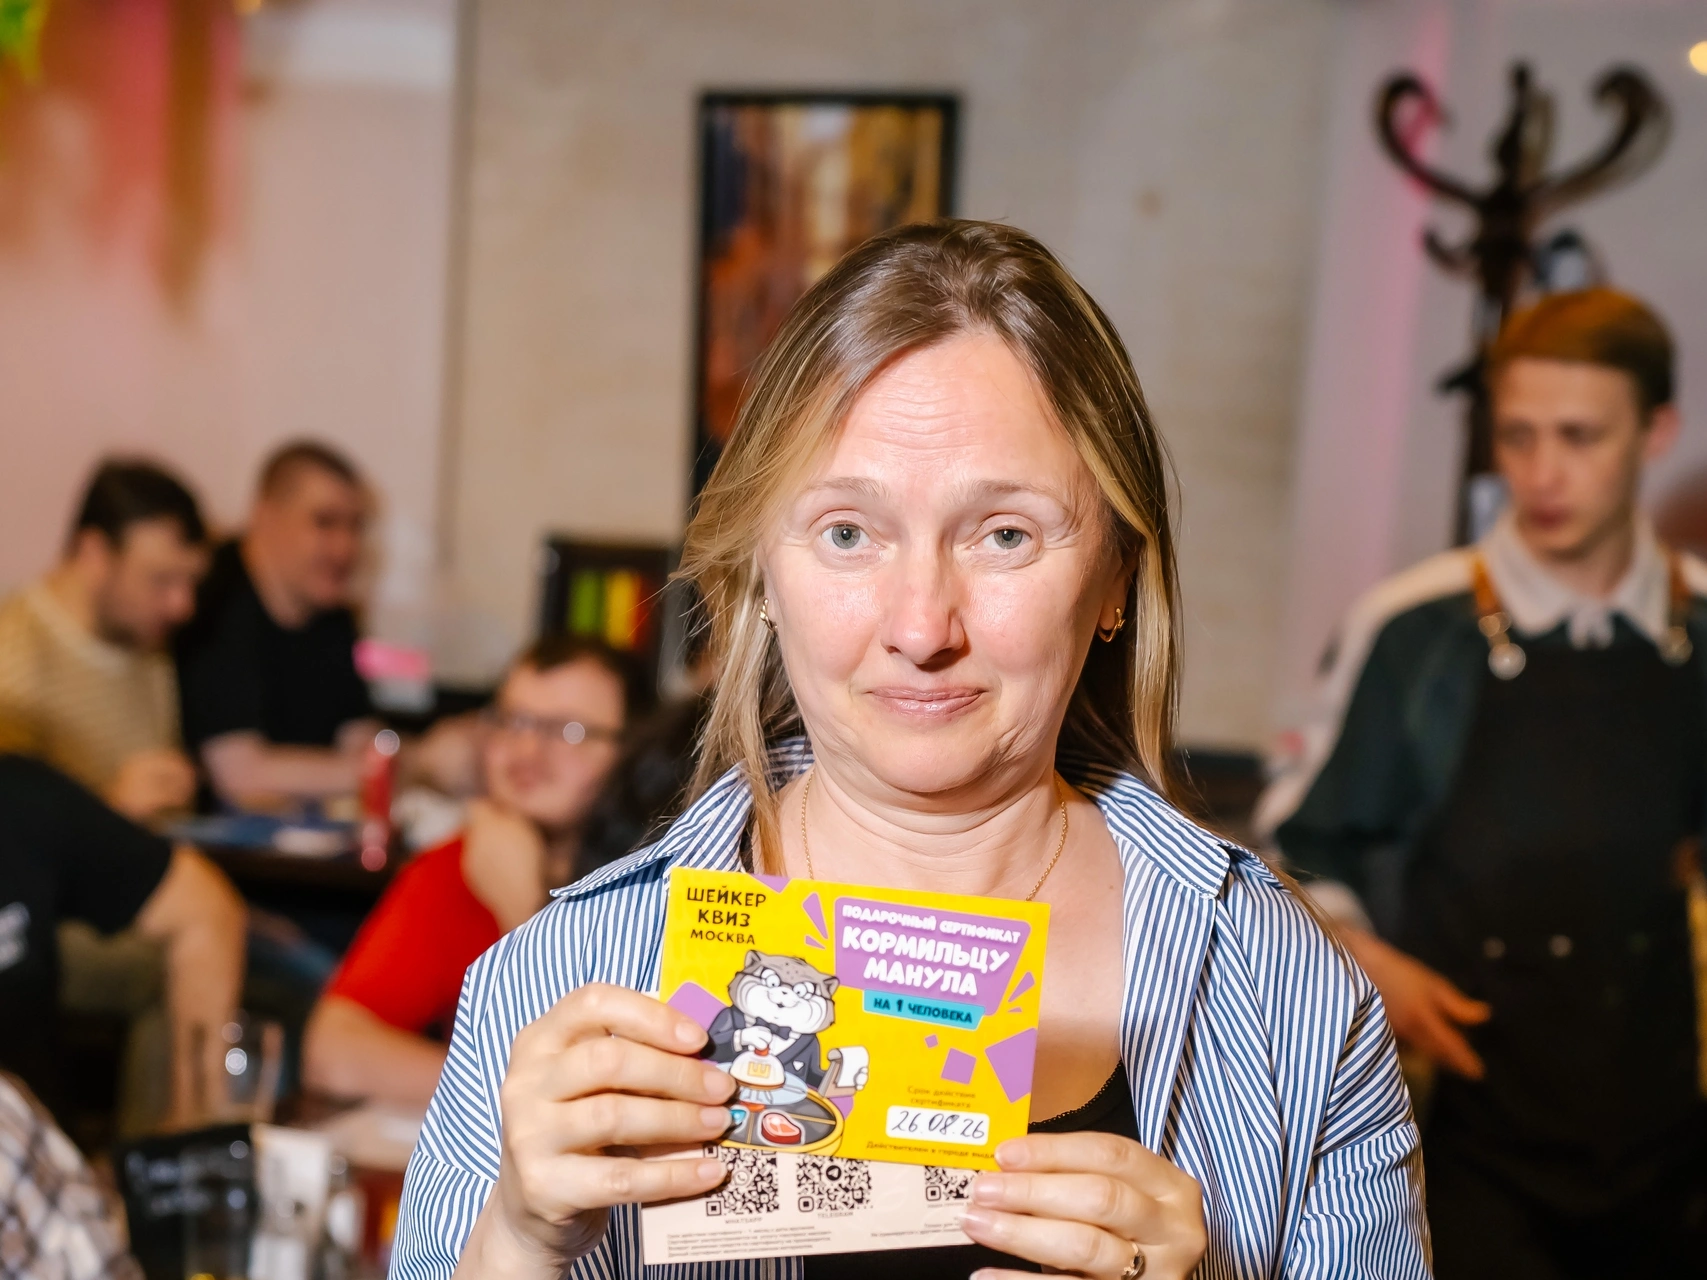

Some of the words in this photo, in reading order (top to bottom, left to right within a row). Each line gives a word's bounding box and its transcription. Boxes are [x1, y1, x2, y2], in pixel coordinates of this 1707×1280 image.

[687, 885, 767, 908] ШЕЙКЕР
[697, 909, 751, 928] КВИЗ
[842, 904, 937, 931] ПОДАРОЧНЫЙ
[939, 920, 1021, 944] СЕРТИФИКАТ
[690, 929, 755, 945] МОСКВА
[842, 926, 1010, 974] КОРМИЛЬЦУ
[863, 957, 978, 996] МАНУЛА
[873, 997, 891, 1011] НА
[897, 999, 903, 1013] 1
[908, 1004, 973, 1024] ЧЕЛОВЕКА
